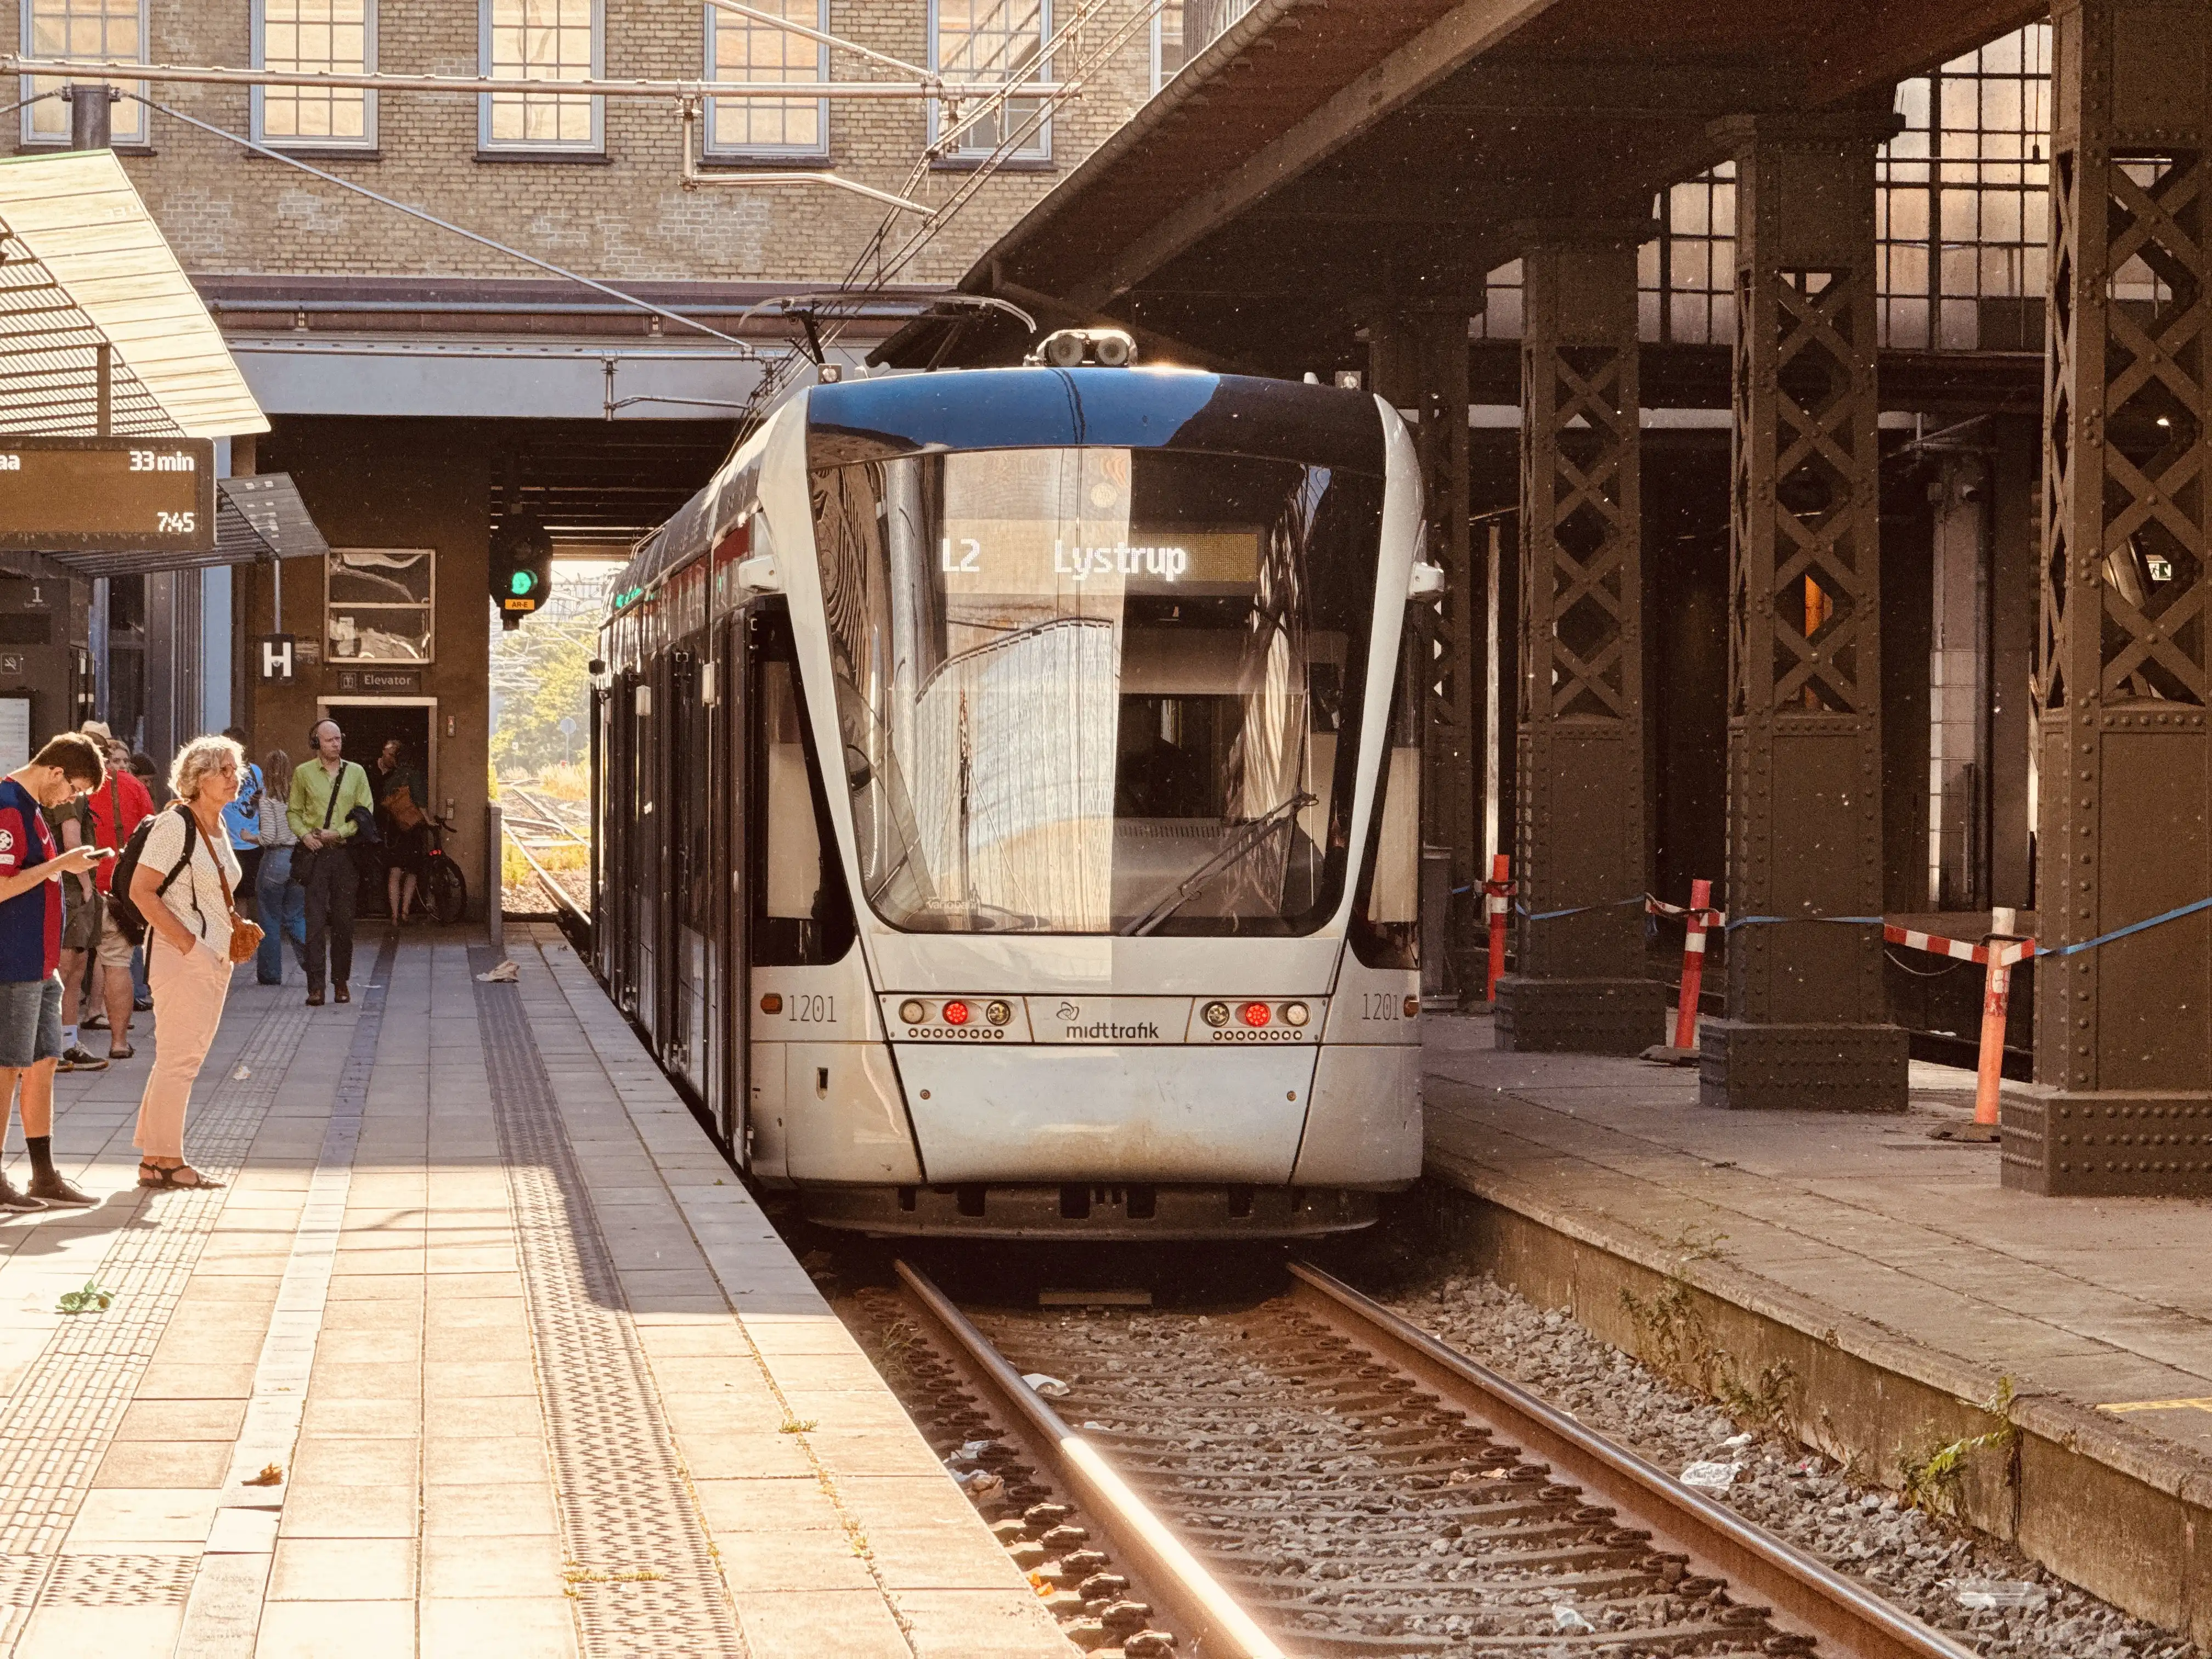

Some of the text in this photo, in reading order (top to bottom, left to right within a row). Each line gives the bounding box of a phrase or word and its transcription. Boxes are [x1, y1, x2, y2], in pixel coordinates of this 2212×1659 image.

[129, 451, 194, 471] 33 min
[157, 512, 194, 532] 7:45
[943, 538, 1186, 581] L2 Lystrup
[32, 586, 43, 602] 1
[263, 642, 291, 677] H
[364, 674, 411, 685] Elevator
[789, 995, 837, 1022] 1201
[1362, 992, 1399, 1020] 1201
[1066, 1022, 1159, 1039] midttrafik
